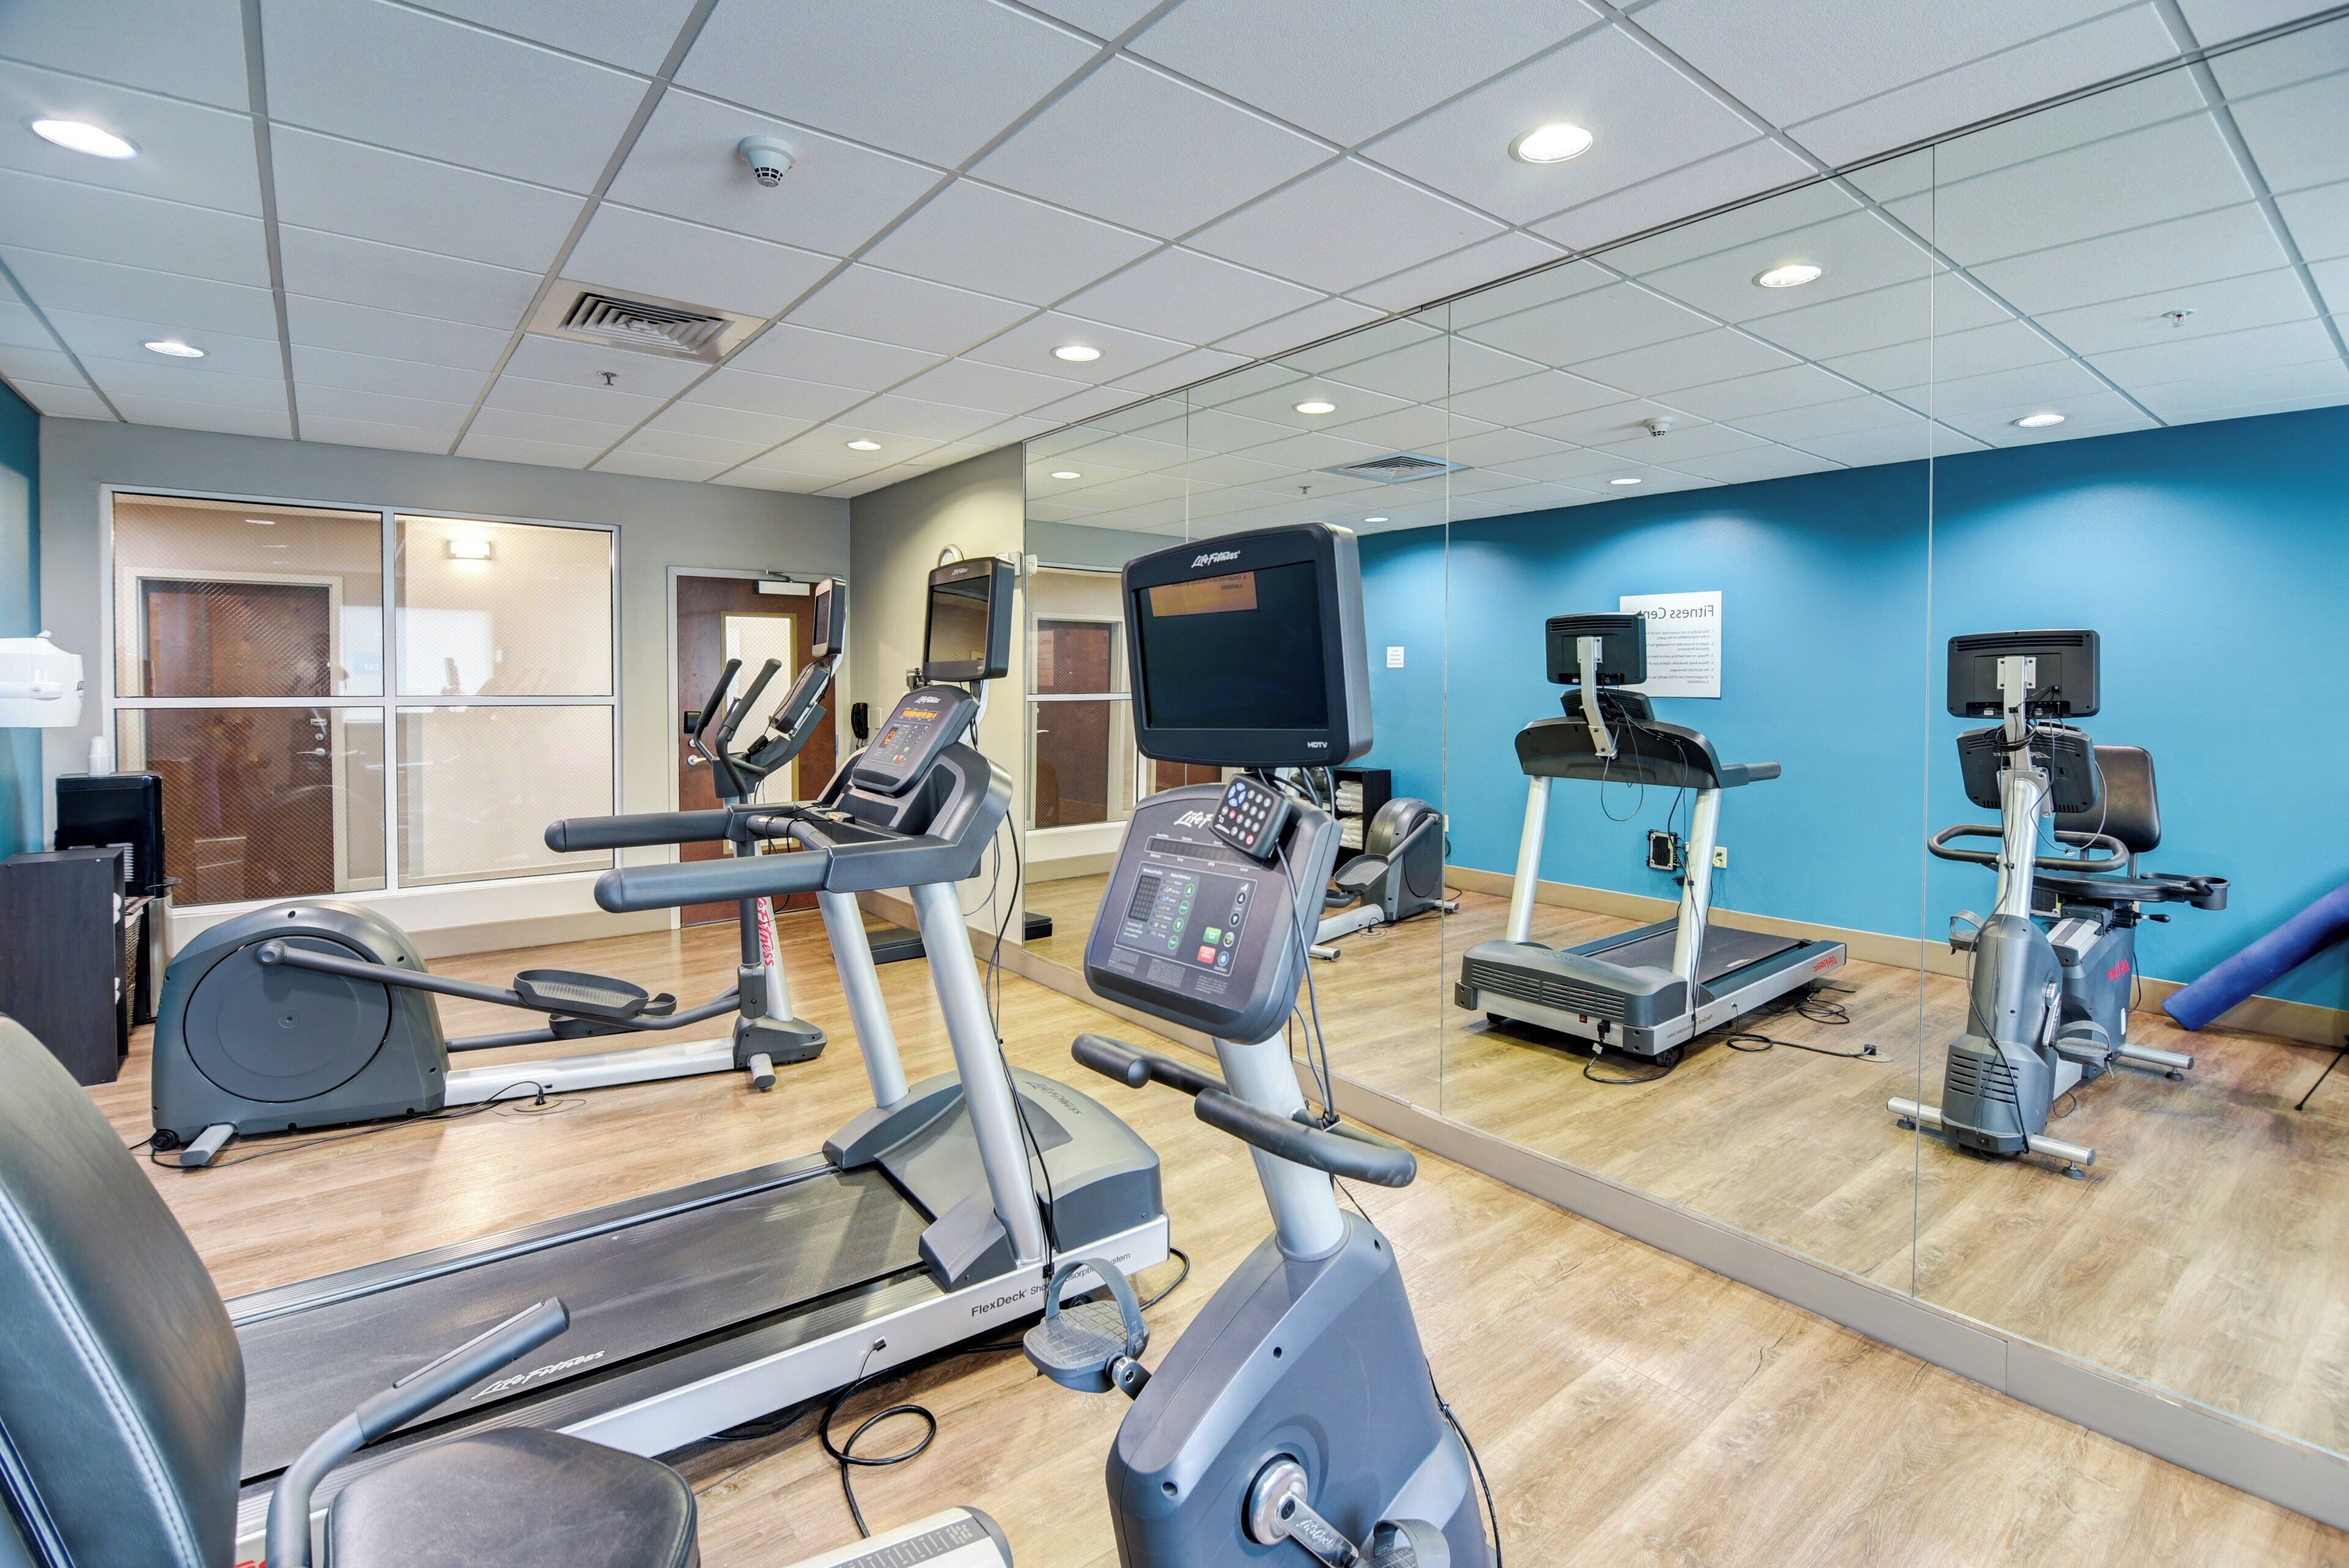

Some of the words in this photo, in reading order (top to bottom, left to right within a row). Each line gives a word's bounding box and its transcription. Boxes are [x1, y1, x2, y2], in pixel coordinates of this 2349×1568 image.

[1191, 553, 1209, 568] Life
[1208, 551, 1239, 566] Fitness
[1173, 810, 1203, 828] Life
[759, 911, 775, 966] Fitness
[971, 1290, 1026, 1317] FlexDeck
[1031, 1282, 1050, 1295] Sho
[1065, 1267, 1095, 1282] sorpti
[1110, 1253, 1130, 1265] stem
[470, 1374, 525, 1400] Life
[522, 1350, 605, 1384] Fitness
